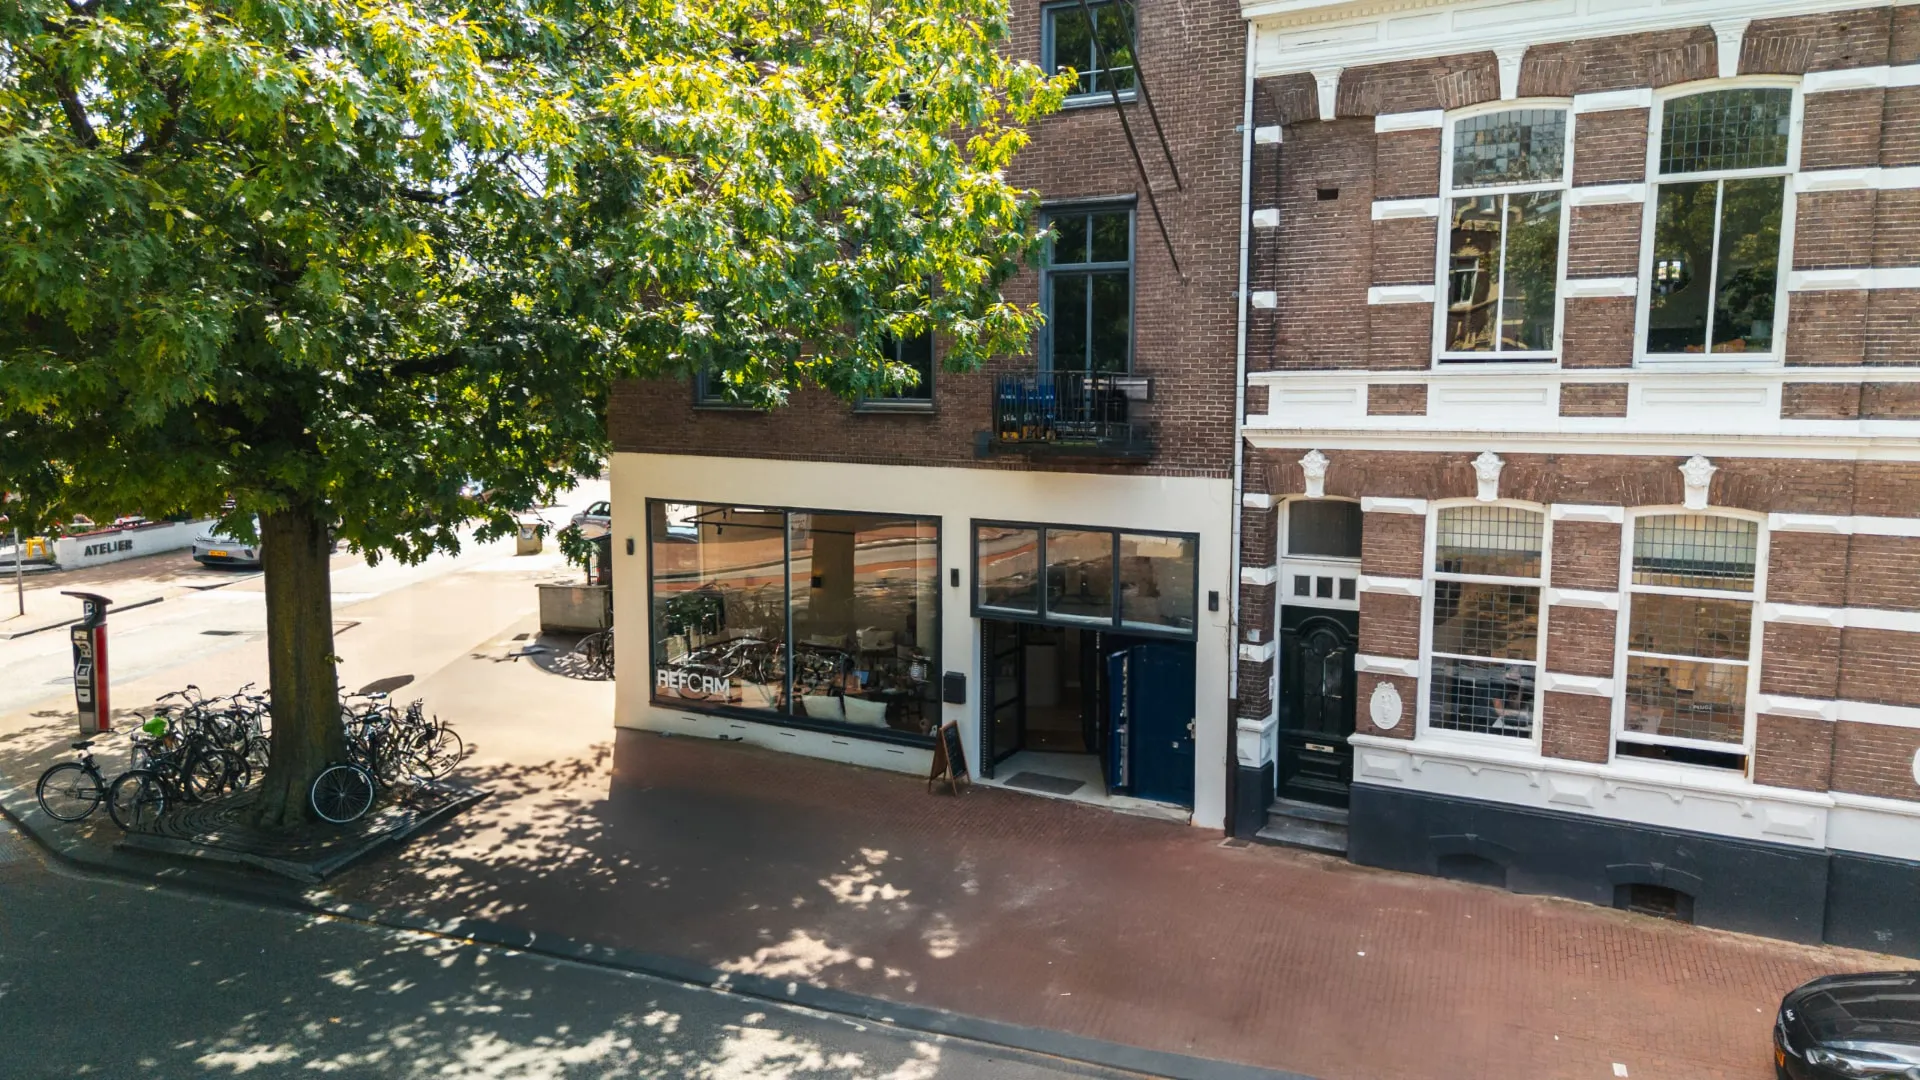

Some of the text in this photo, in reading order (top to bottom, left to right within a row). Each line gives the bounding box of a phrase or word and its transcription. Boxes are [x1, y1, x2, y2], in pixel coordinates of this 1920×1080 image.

[84, 539, 133, 556] ATELIER
[85, 603, 93, 613] P
[657, 669, 730, 696] REFORM
